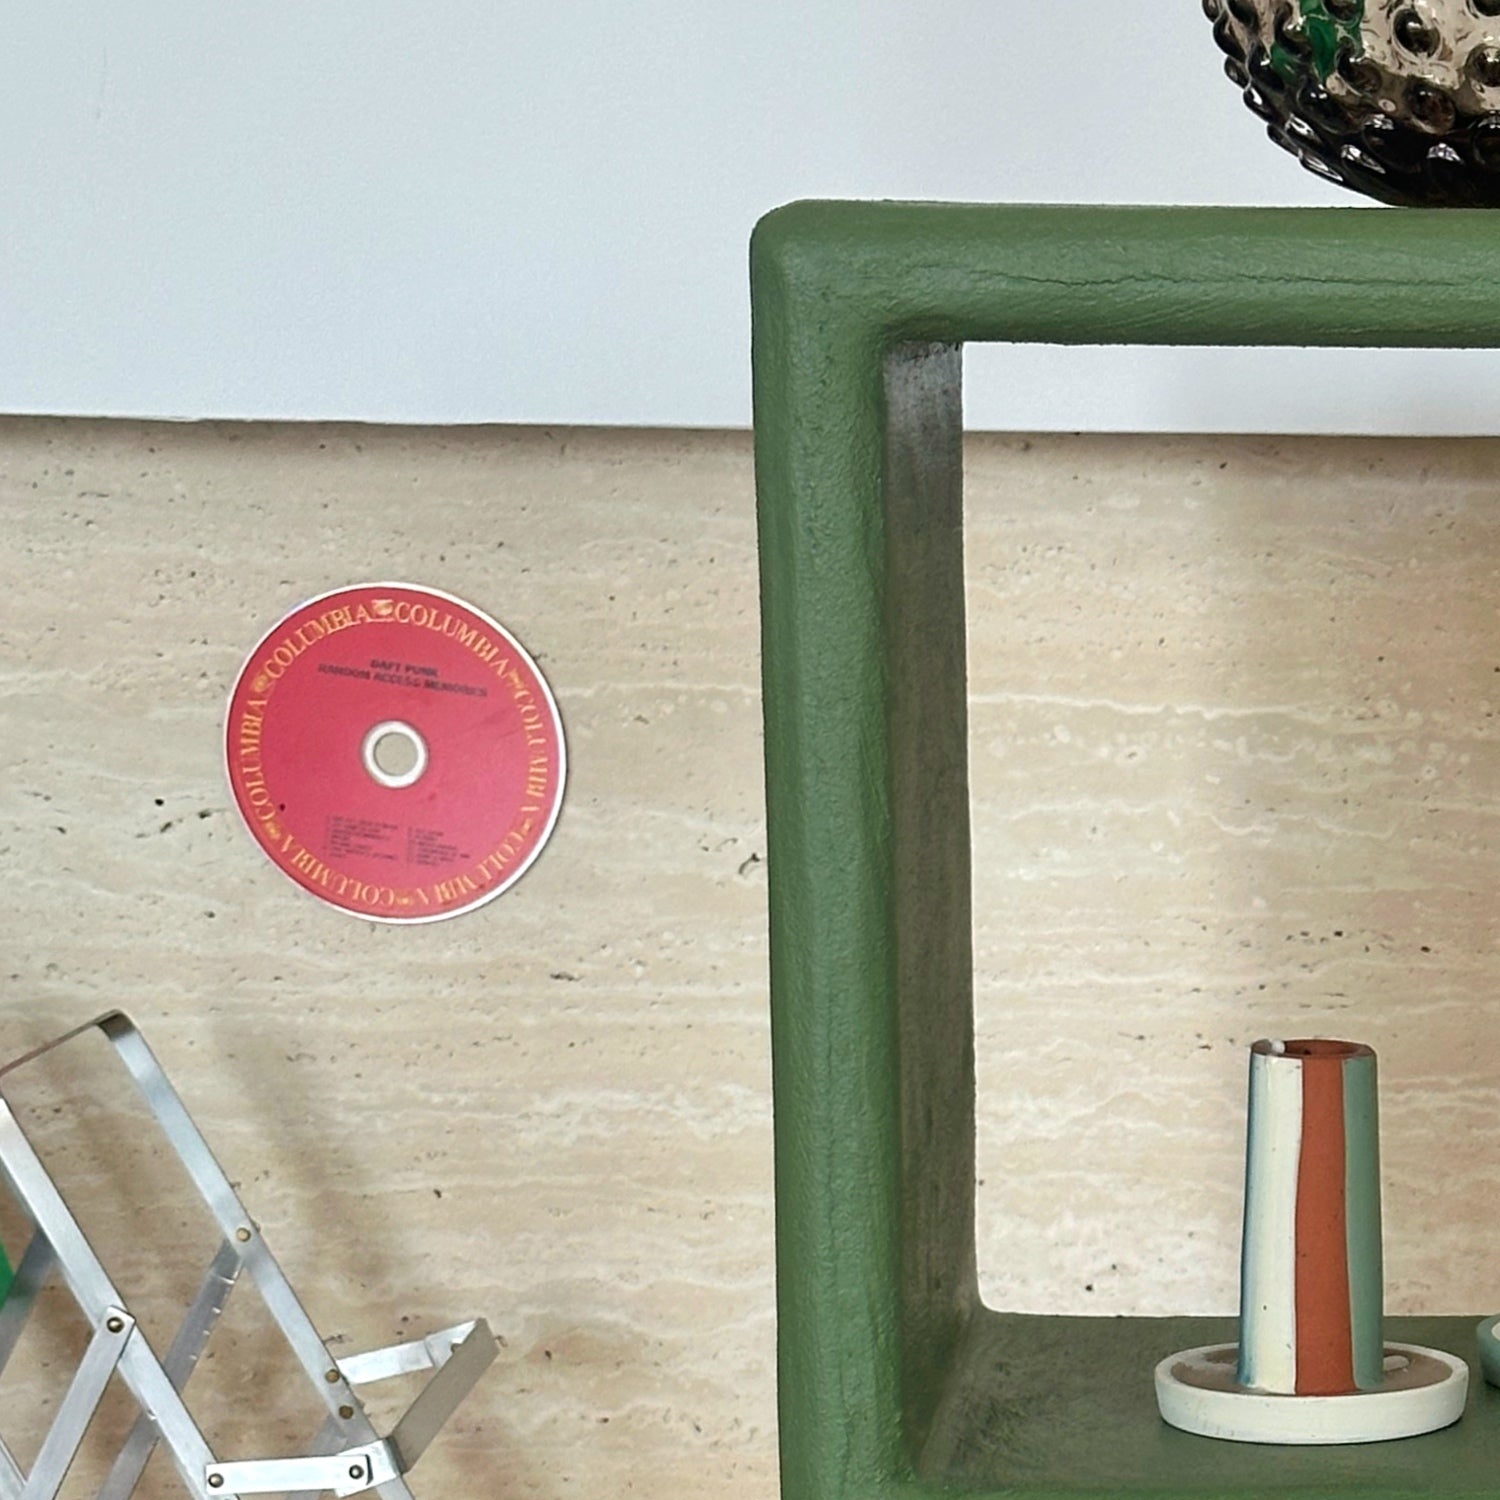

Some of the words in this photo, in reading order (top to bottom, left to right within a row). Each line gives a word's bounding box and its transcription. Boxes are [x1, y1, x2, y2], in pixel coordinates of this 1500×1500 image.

[263, 603, 373, 680] COLUMBIA
[370, 659, 400, 672] DAFT
[404, 663, 438, 677] PUNK
[394, 602, 510, 680] COLUMBIA
[241, 697, 276, 821] COLUMBIA
[513, 690, 548, 813] COLUMBIA
[279, 834, 396, 906] COLUMBIA
[417, 830, 526, 906] COLUMBIA
